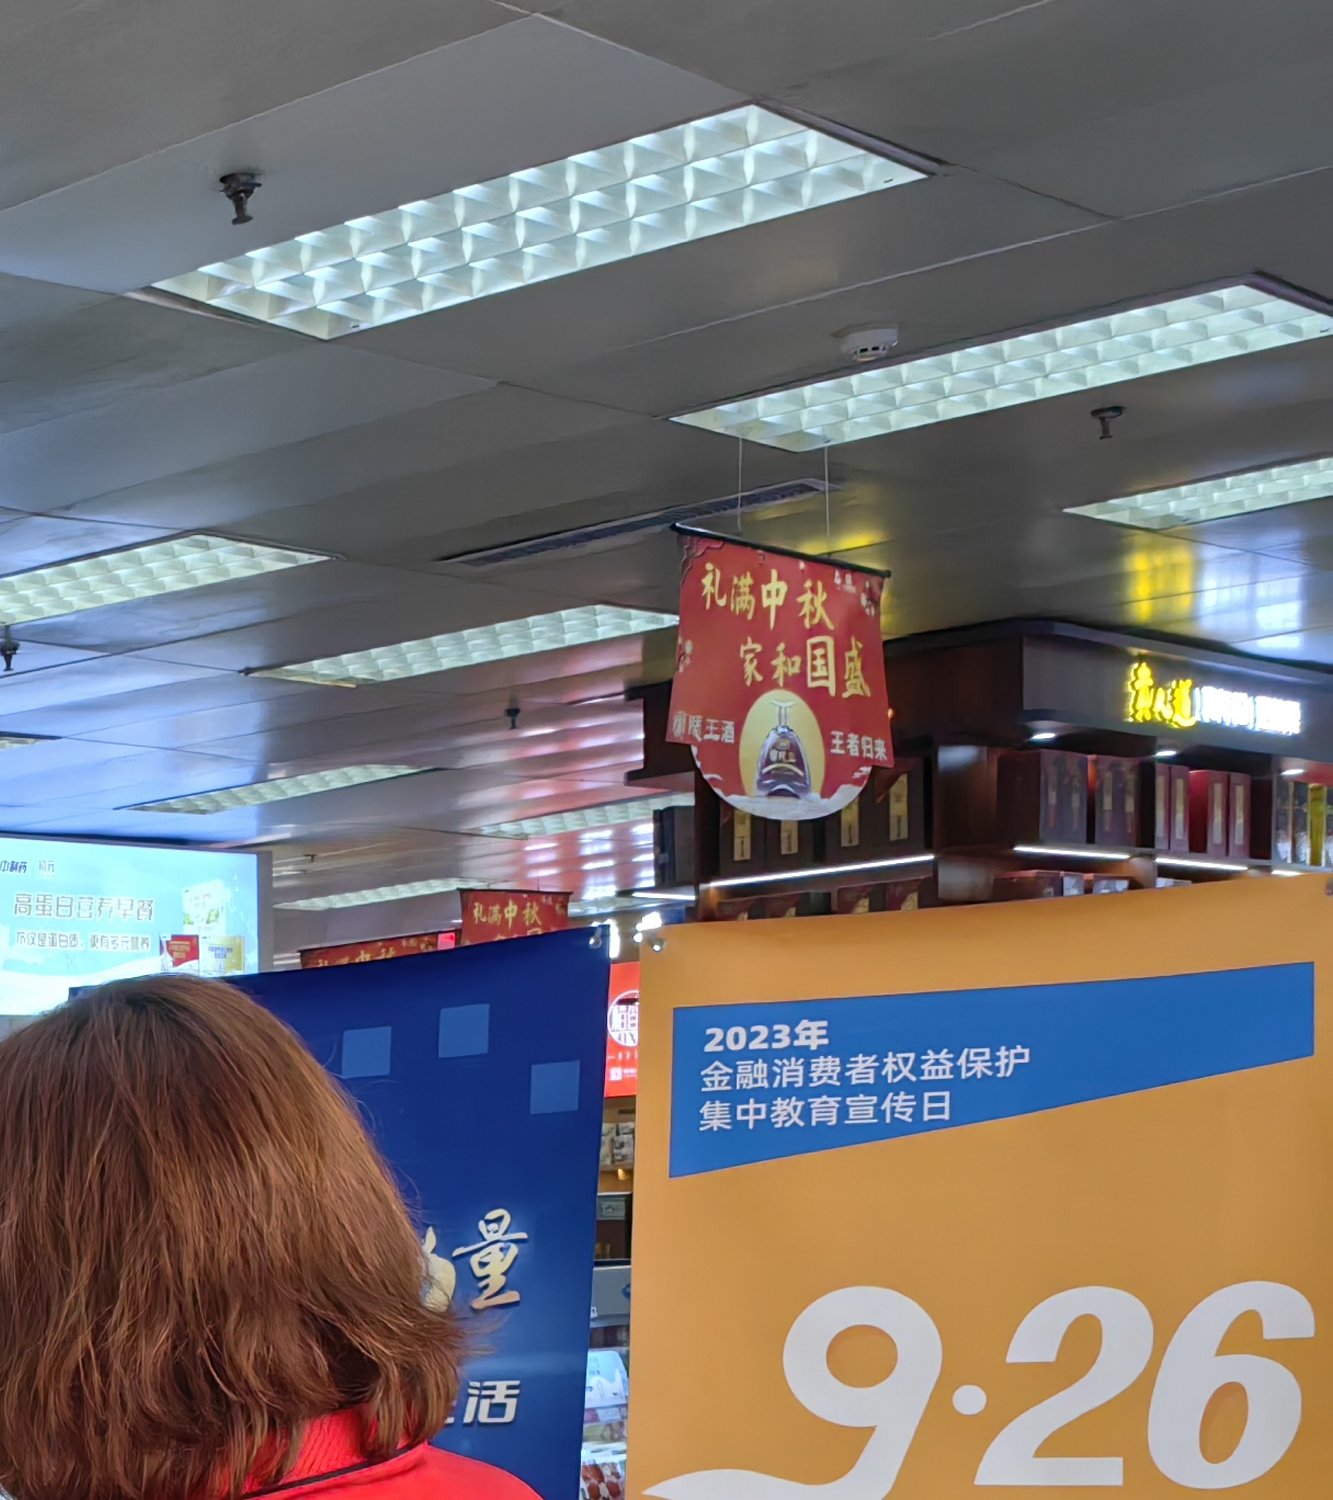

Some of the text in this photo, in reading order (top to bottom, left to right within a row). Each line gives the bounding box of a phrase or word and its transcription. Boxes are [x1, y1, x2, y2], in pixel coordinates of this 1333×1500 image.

[701, 562, 835, 631] 礼满中秋
[739, 635, 871, 698] 家和国盛
[830, 730, 888, 761] 王者归来
[14, 893, 154, 921] 高蛋白营养早餐
[703, 1019, 830, 1053] 2023年
[700, 1044, 1031, 1093] 金融消费者权益保护
[699, 1091, 952, 1132] 集中教育宣传日
[445, 1380, 521, 1424] 活
